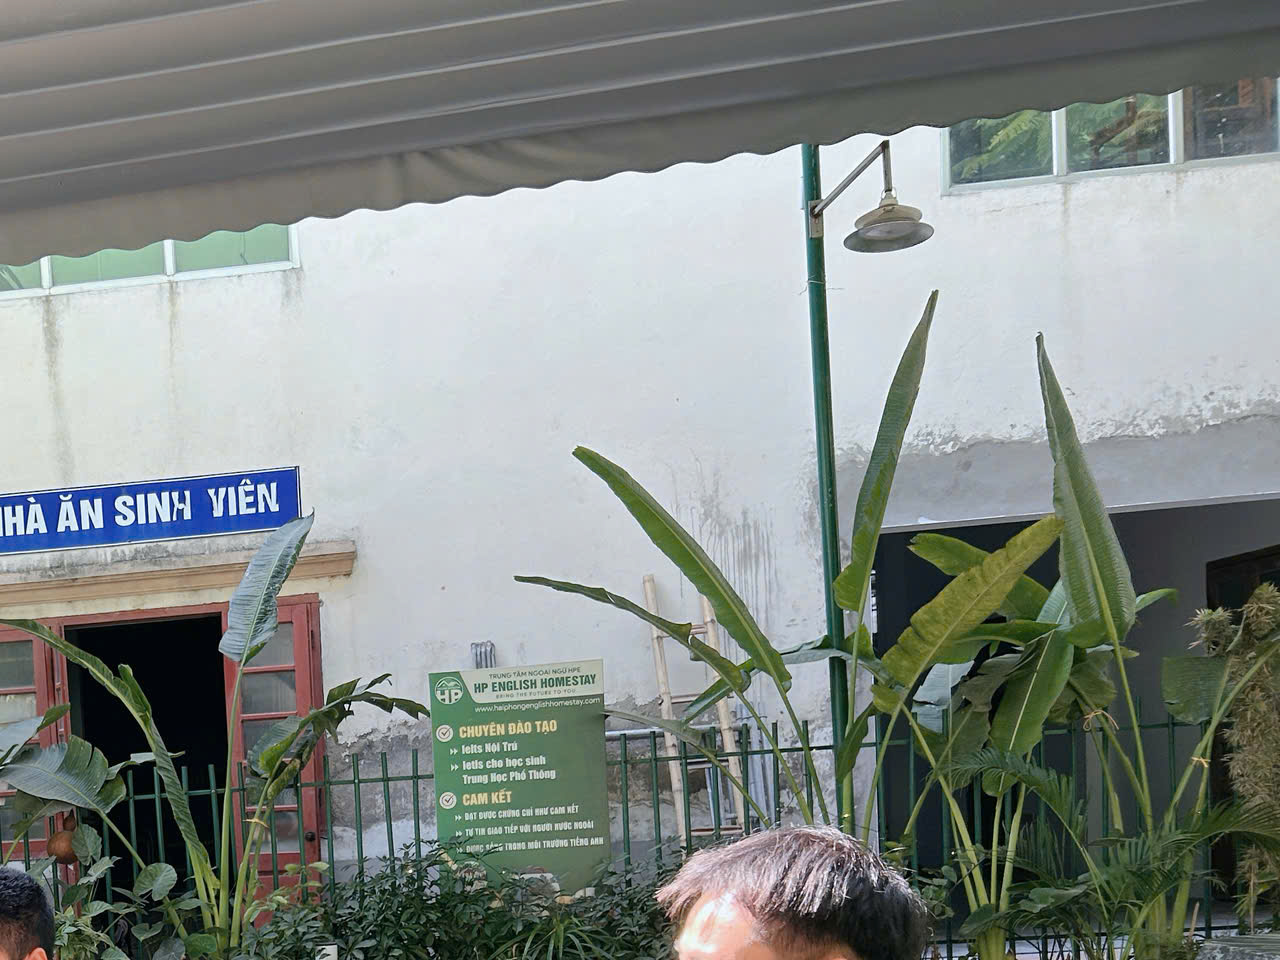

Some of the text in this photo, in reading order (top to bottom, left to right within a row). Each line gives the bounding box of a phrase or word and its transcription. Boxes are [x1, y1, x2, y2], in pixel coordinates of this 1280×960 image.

[56, 493, 103, 532] ĂN
[114, 489, 192, 527] SINH
[207, 479, 279, 518] VIÊN
[489, 672, 511, 680] TRUNG
[474, 674, 596, 693] HP ENGLISH HOMESTAY
[459, 720, 557, 738] CHUYÊN ĐÀO TẠO
[485, 742, 500, 753] Nội
[502, 741, 518, 752] Trú
[486, 759, 503, 768] cho
[506, 757, 523, 768] học
[526, 755, 546, 766] sinh
[462, 774, 488, 784] Trung
[490, 773, 507, 783] Học
[528, 769, 556, 780] Thông
[462, 788, 512, 806] CAM KẾT
[550, 806, 566, 815] CAM
[487, 827, 503, 835] GIAO
[504, 823, 518, 834] TIẾP
[590, 837, 603, 846] ANH
